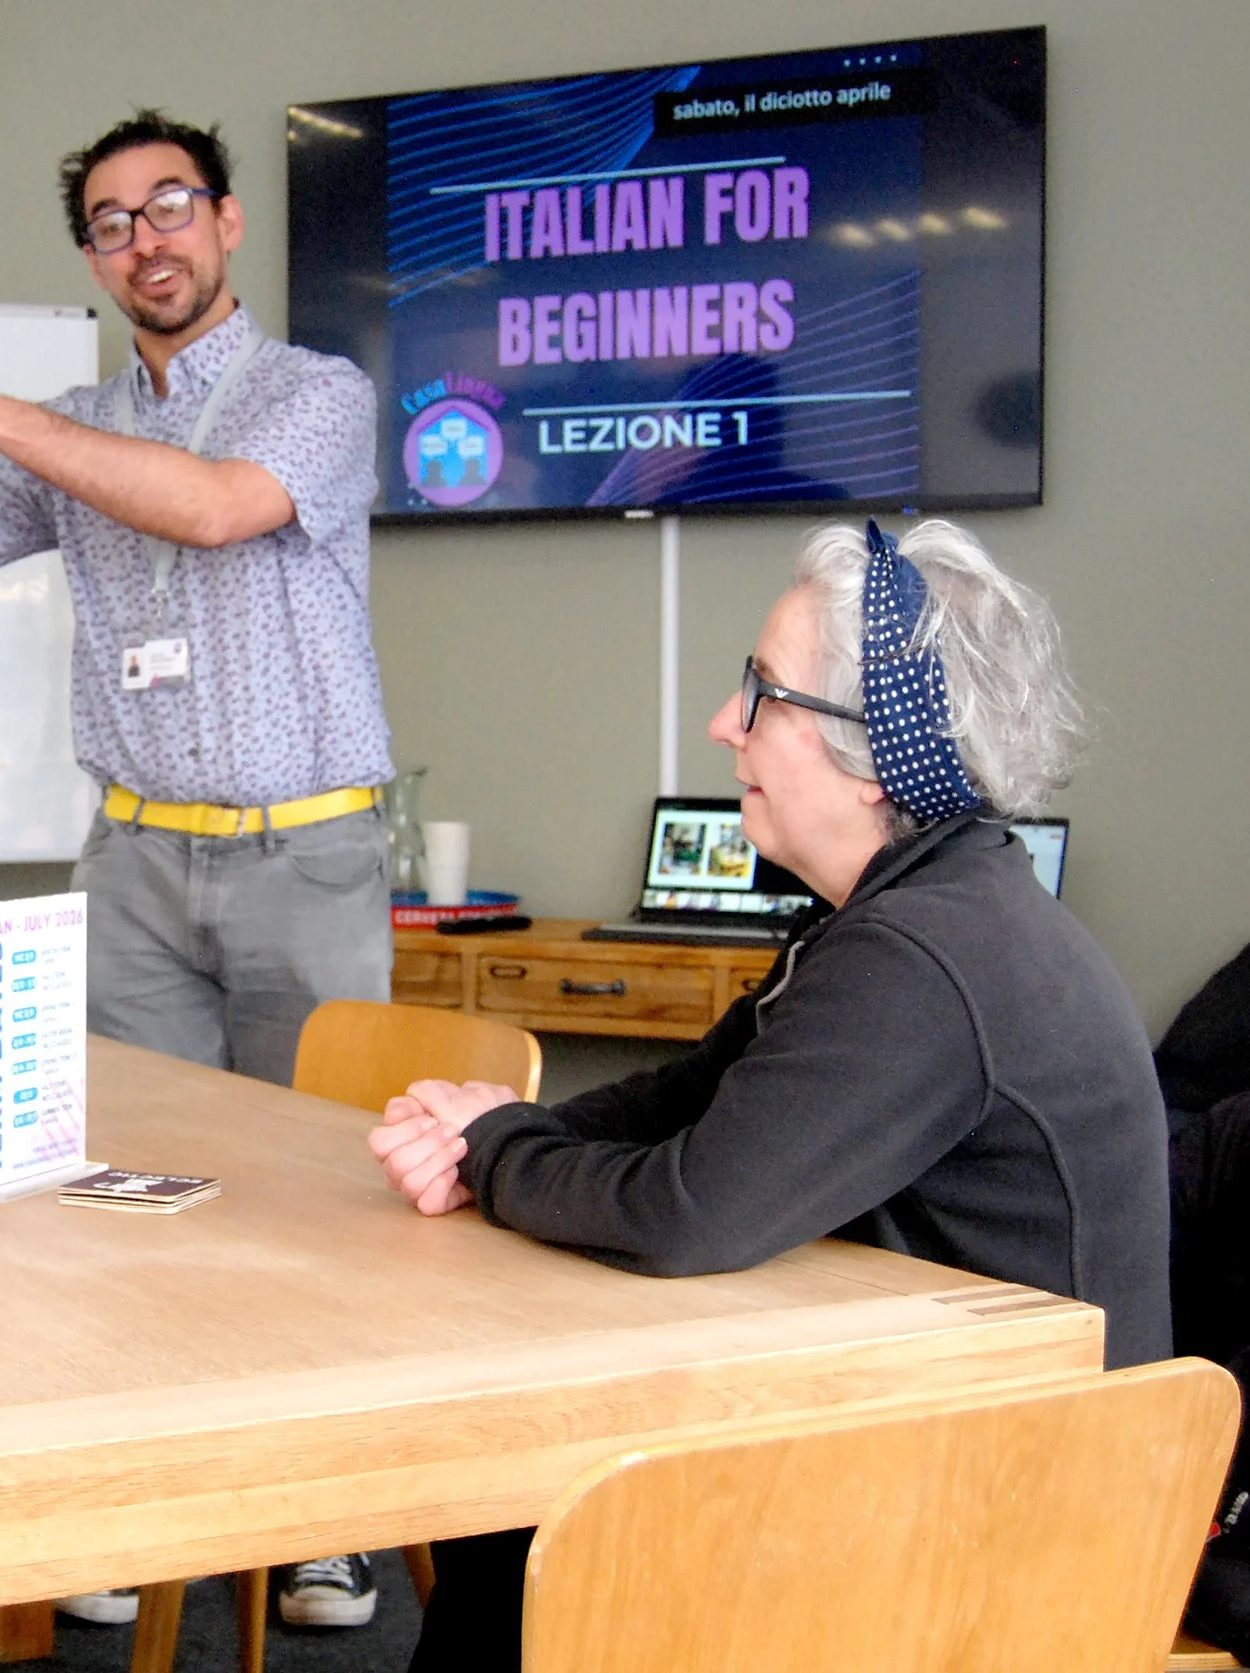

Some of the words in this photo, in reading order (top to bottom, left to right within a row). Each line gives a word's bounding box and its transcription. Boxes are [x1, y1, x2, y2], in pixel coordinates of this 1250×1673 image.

[673, 99, 740, 120] sabato,
[744, 93, 756, 113] il
[760, 89, 833, 111] diciotto
[836, 81, 892, 108] aprile
[485, 176, 685, 262] ITALIAN
[704, 166, 810, 246] FOR
[498, 279, 795, 368] BEGINNERS
[538, 411, 722, 455] LEZIONE
[732, 410, 748, 446] 1
[24, 913, 52, 932] JULY
[55, 908, 84, 928] 2026
